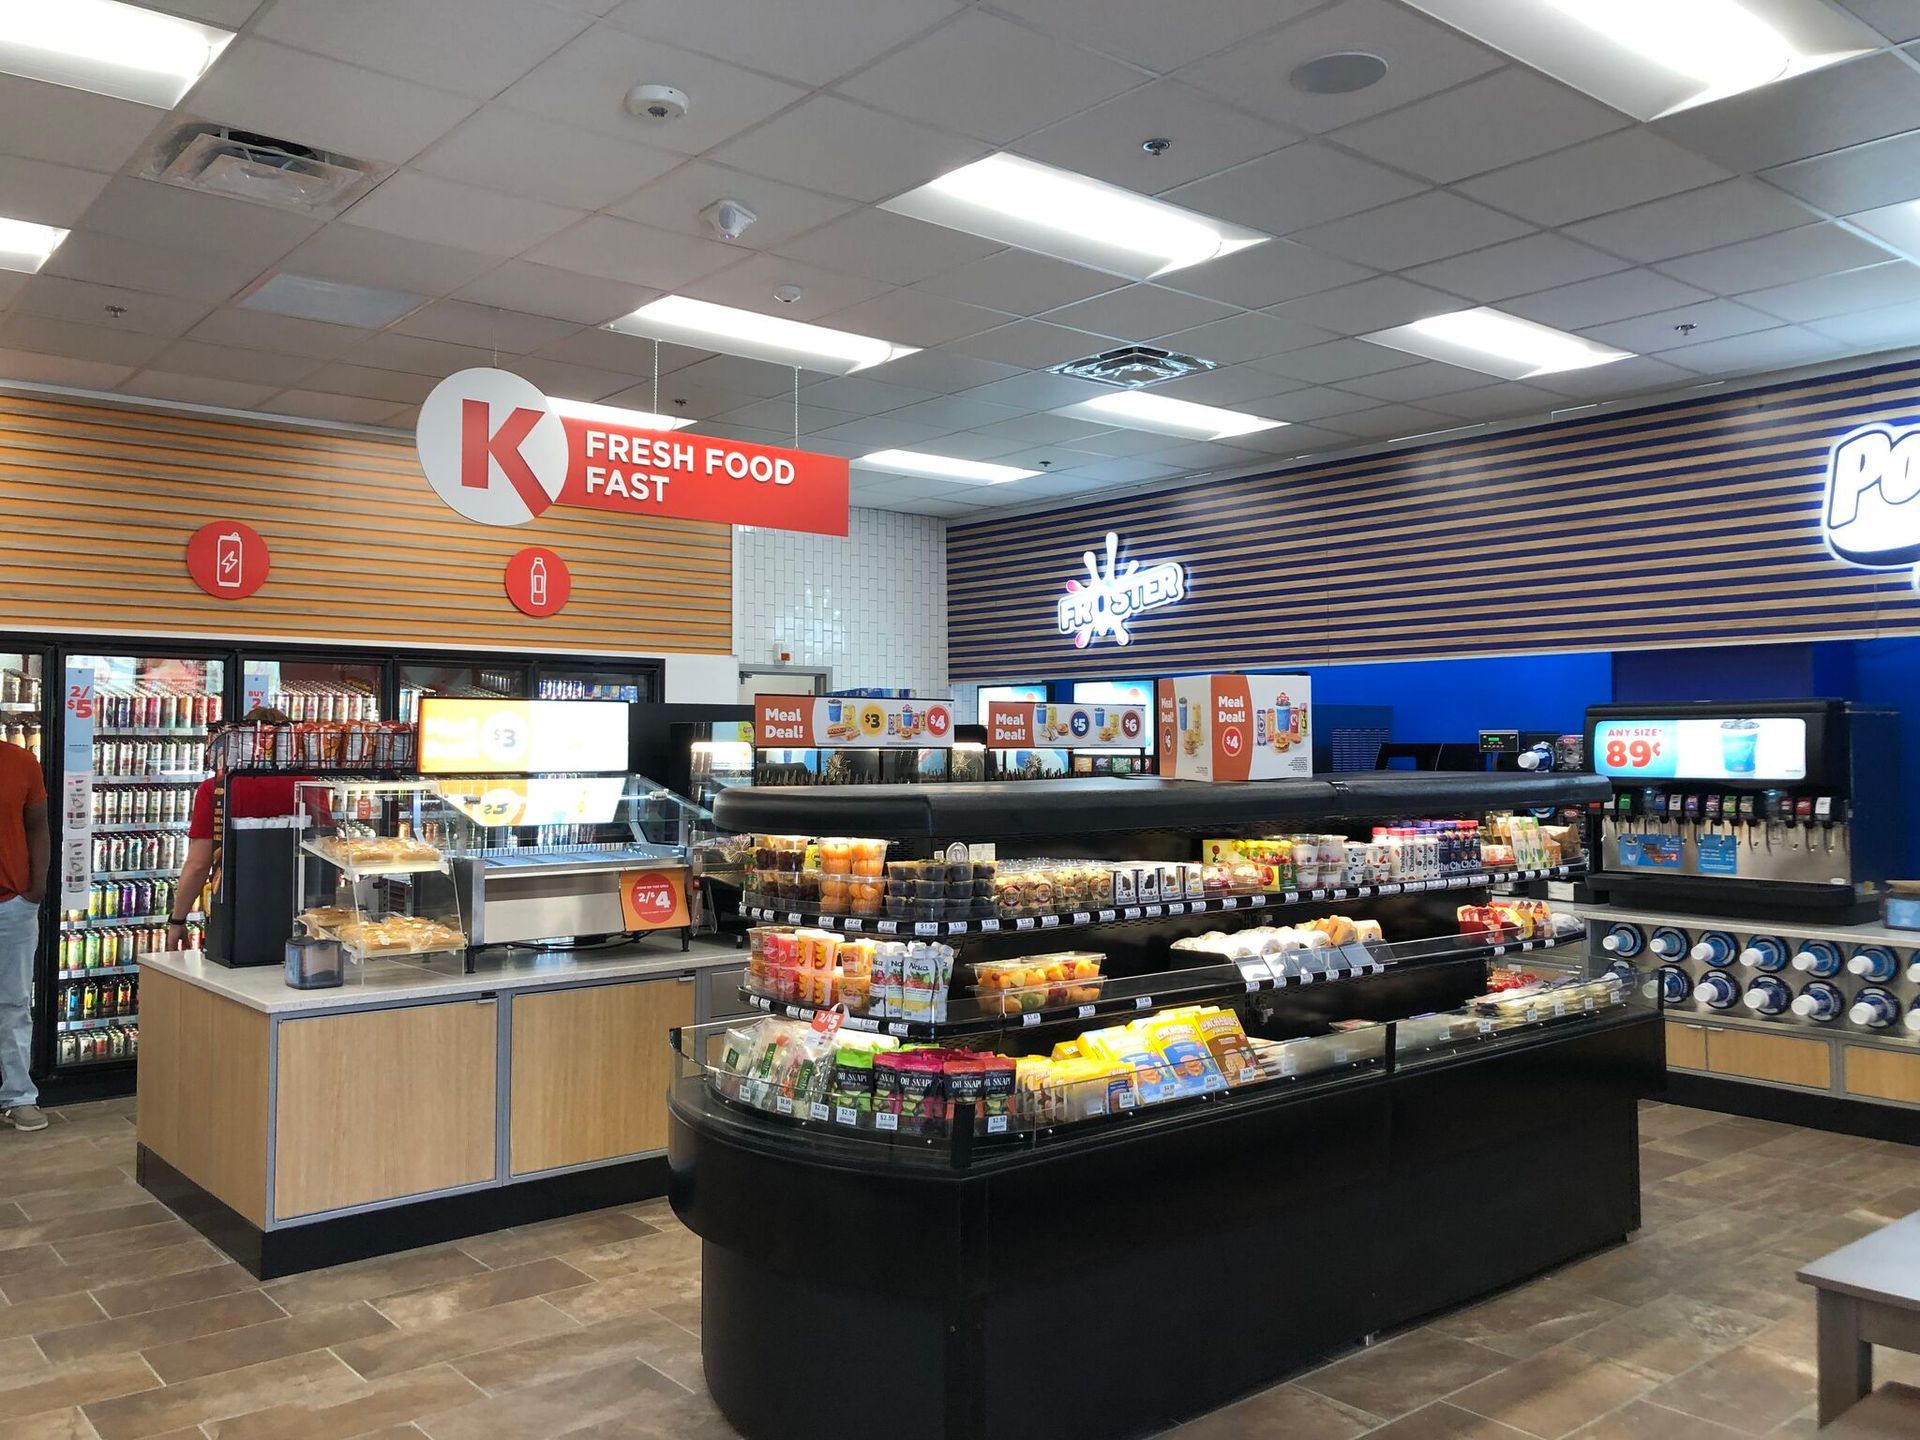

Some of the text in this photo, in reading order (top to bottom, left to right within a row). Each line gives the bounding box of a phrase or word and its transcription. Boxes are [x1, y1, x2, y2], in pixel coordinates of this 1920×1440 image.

[461, 398, 555, 518] K
[586, 430, 795, 485] FRESH FOOD
[586, 466, 670, 502] FAST
[1059, 564, 1182, 633] FROSTER
[70, 686, 91, 699] 2/
[1218, 695, 1243, 708] Meal
[67, 699, 93, 719] $5
[765, 708, 802, 722] Meal
[865, 713, 880, 728] $3
[930, 714, 946, 730] $4
[995, 713, 1025, 726] Meal
[1218, 711, 1245, 723] Deal!
[765, 725, 804, 739] Deal!
[1073, 718, 1087, 732] $5
[1125, 718, 1137, 732] $6
[494, 728, 516, 748] $3
[995, 728, 1026, 741] Deal!
[1608, 729, 1629, 738] ANY
[1226, 735, 1239, 749] $4
[1606, 740, 1661, 768] 89¢
[814, 1103, 828, 1112] $2.59
